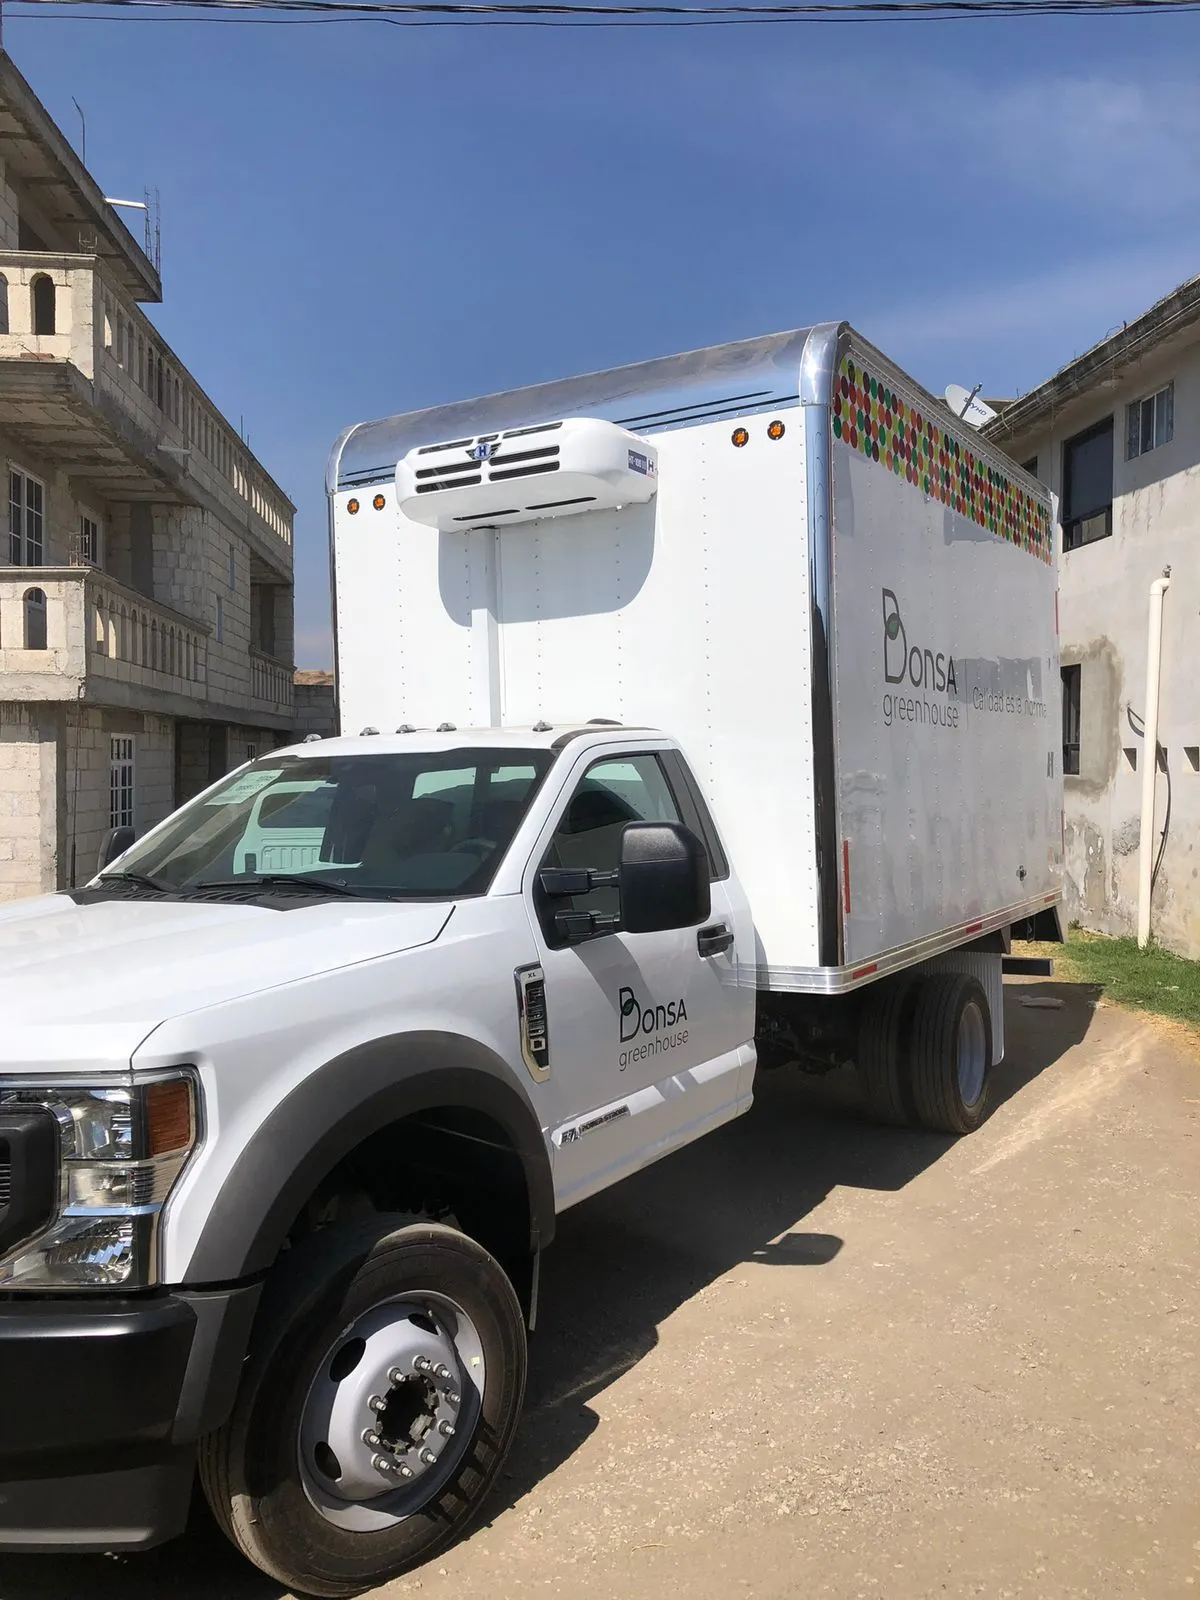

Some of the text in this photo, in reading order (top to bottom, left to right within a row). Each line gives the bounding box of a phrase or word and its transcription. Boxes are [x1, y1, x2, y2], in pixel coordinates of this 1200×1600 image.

[883, 693, 960, 728] greenhouse
[527, 971, 536, 979] XL
[619, 1030, 689, 1072] greenhouse
